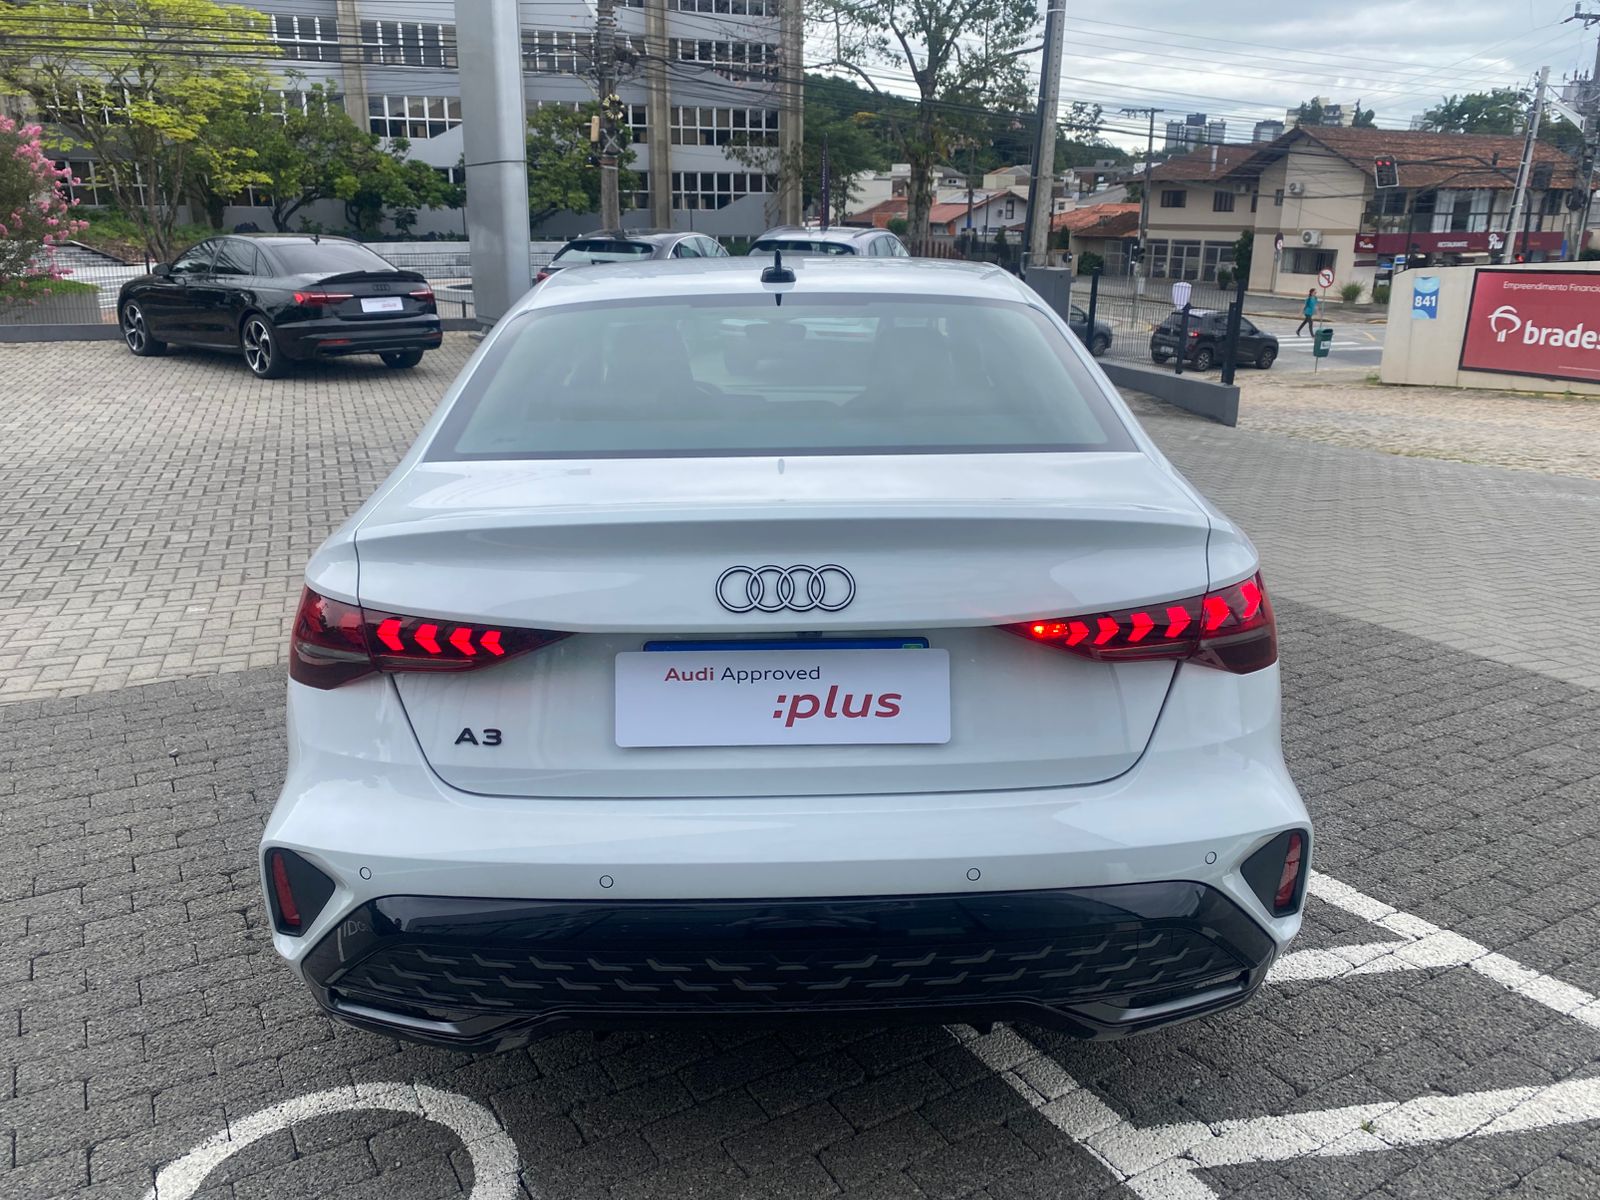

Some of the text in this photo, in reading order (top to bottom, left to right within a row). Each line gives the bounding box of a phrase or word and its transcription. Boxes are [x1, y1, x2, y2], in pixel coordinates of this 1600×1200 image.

[1503, 281, 1568, 292] Empreendimento
[1415, 295, 1436, 307] 841
[664, 665, 820, 685] Audi Approved
[454, 727, 502, 746] A3
